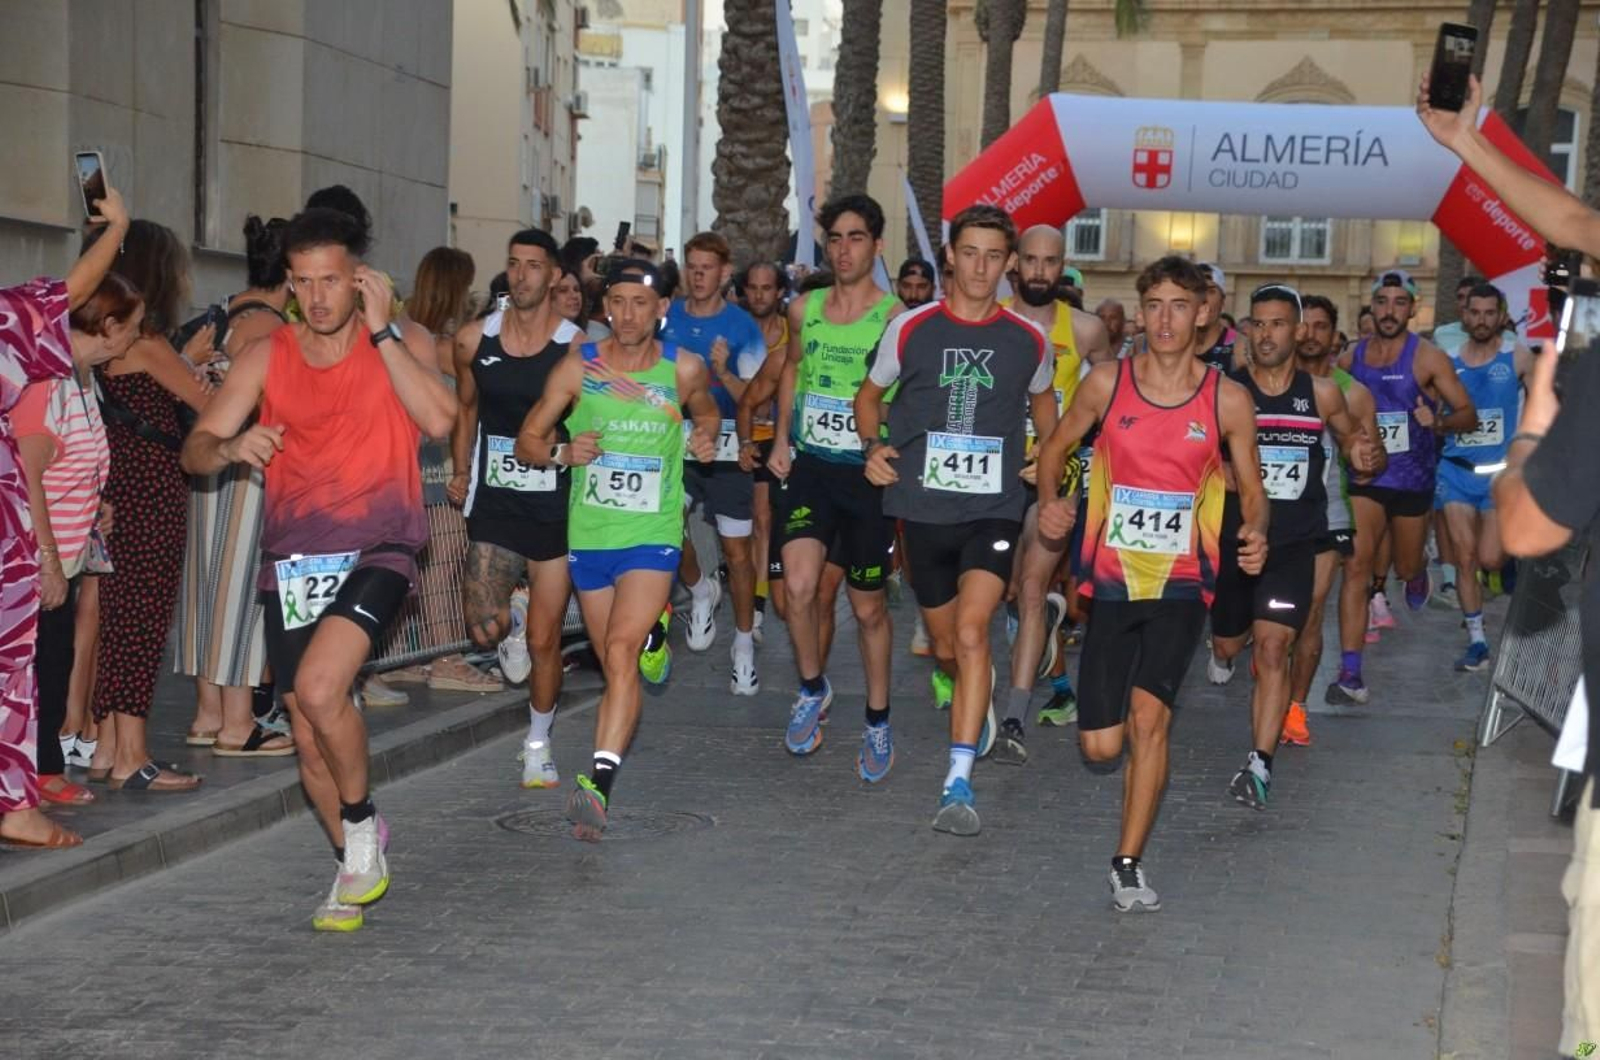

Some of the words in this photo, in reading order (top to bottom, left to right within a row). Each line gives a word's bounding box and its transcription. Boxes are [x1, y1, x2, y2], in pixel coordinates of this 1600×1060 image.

[1210, 129, 1390, 167] ALMERÍA
[1003, 166, 1060, 214] deporte
[1207, 167, 1299, 190] CIUDAD
[1481, 197, 1537, 251] deporte
[821, 352, 854, 366] Unicaja
[822, 342, 869, 357] Fundación
[943, 347, 995, 379] IX
[607, 419, 667, 435] SAKATA
[816, 411, 859, 433] 450
[930, 435, 947, 449] IX
[942, 452, 990, 475] 411
[608, 470, 643, 493] 50
[1115, 488, 1132, 504] IX
[1127, 508, 1183, 534] 414
[305, 574, 340, 600] 22
